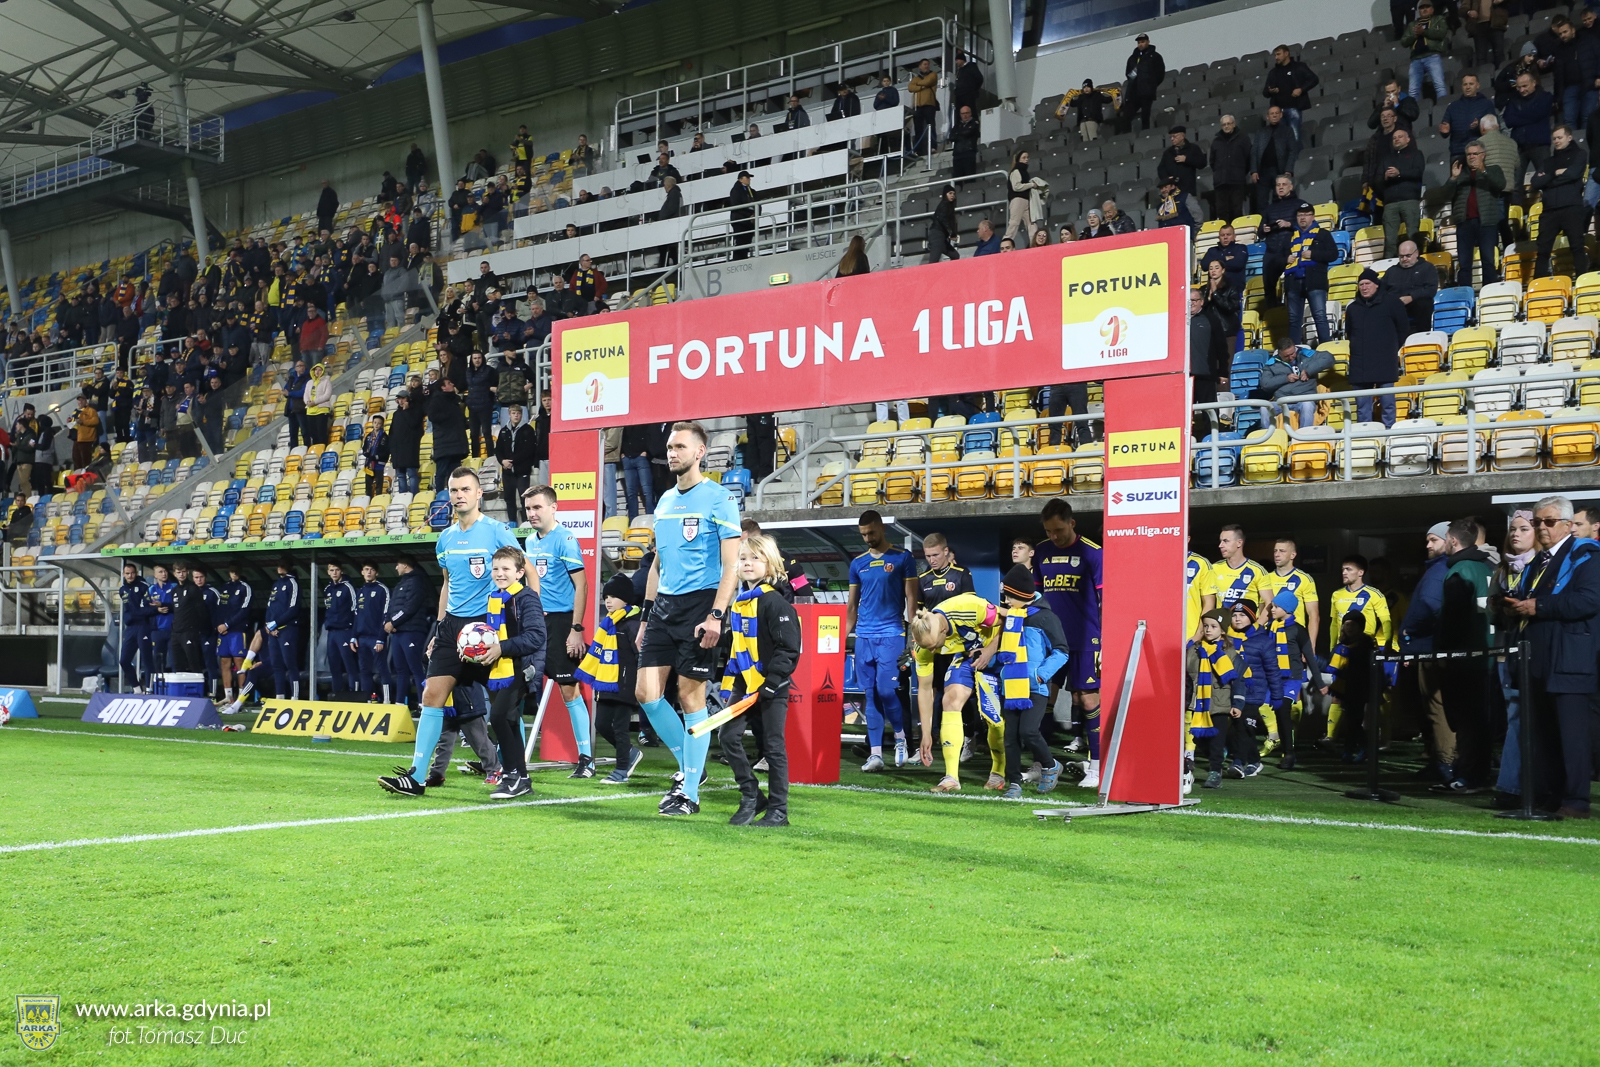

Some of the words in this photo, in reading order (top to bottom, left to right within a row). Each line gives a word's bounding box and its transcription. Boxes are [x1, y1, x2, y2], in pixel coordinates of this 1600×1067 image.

[805, 249, 836, 262] WEJŚCIE
[726, 263, 753, 275] SEKTOR
[707, 269, 722, 297] B
[1068, 272, 1162, 298] FORTUNA
[648, 317, 885, 384] FORTUNA
[912, 308, 930, 354] 1
[942, 296, 1033, 350] LIGA
[565, 345, 625, 363] FORTUNA
[1107, 347, 1128, 358] LIGA
[590, 404, 604, 412] LIGA
[1112, 441, 1176, 455] FORTUNA
[553, 482, 593, 490] FORTUNA
[1126, 491, 1178, 502] SUZUKI
[1107, 526, 1181, 538] www.1liga.org
[1043, 574, 1081, 588] forBET
[817, 693, 837, 703] SELECT
[98, 698, 191, 727] 4MOVE
[256, 708, 391, 736] FORTUNA
